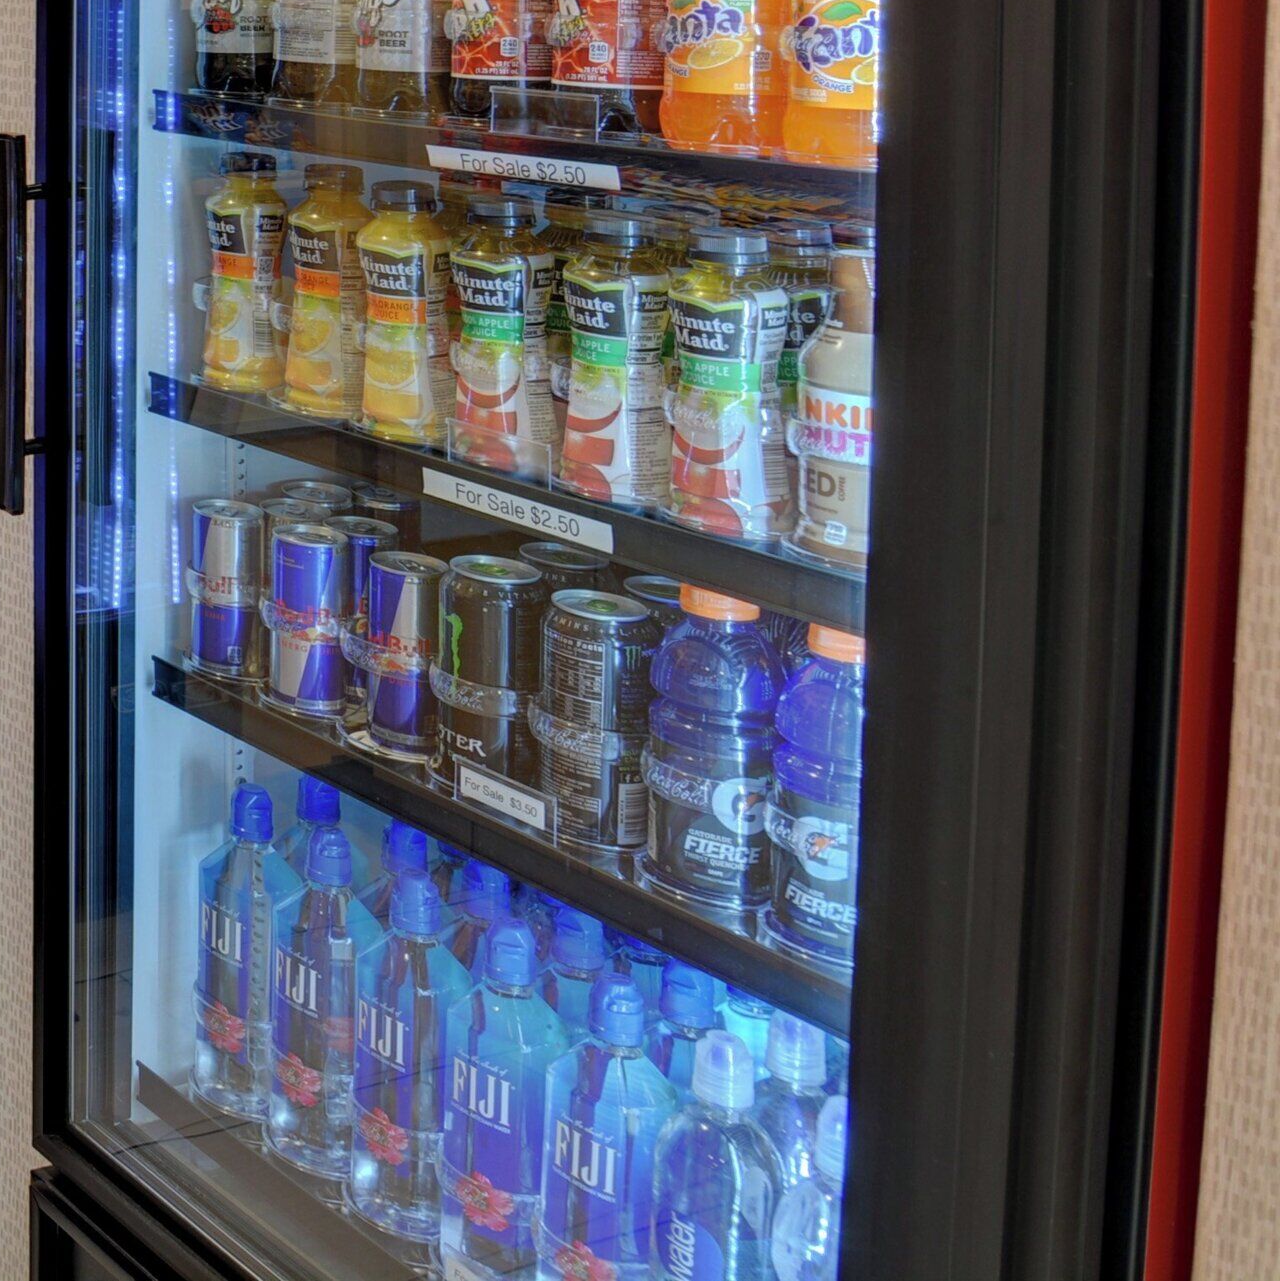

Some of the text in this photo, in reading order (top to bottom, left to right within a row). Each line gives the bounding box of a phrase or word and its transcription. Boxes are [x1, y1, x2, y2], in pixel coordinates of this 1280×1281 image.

[378, 30, 409, 39] ROOT
[379, 39, 407, 48] BEER
[502, 39, 518, 48] 240
[590, 44, 607, 53] 240
[812, 75, 853, 93] ORANGE
[460, 152, 587, 186] For Sale $2.50
[360, 256, 420, 277] Minute
[366, 271, 413, 291] Maid
[453, 271, 514, 292] Minute
[459, 287, 509, 307] Maid
[478, 317, 510, 329] APPLE
[671, 306, 736, 335] Minute
[471, 327, 497, 337] JUICE
[674, 327, 730, 352] Maid
[580, 339, 611, 353] APPLE
[694, 363, 731, 377] APPLE
[455, 483, 580, 539] For Sale $2.50
[389, 633, 432, 655] Bull
[464, 776, 538, 819] For Sale $3.50
[684, 834, 762, 865] FIERCE
[784, 883, 858, 926] FIERCE
[202, 906, 244, 964] FIJI
[275, 947, 319, 1013] FIJI
[357, 999, 406, 1068] FIJI
[453, 1056, 511, 1127] FIJI
[554, 1120, 617, 1196] FIJI
